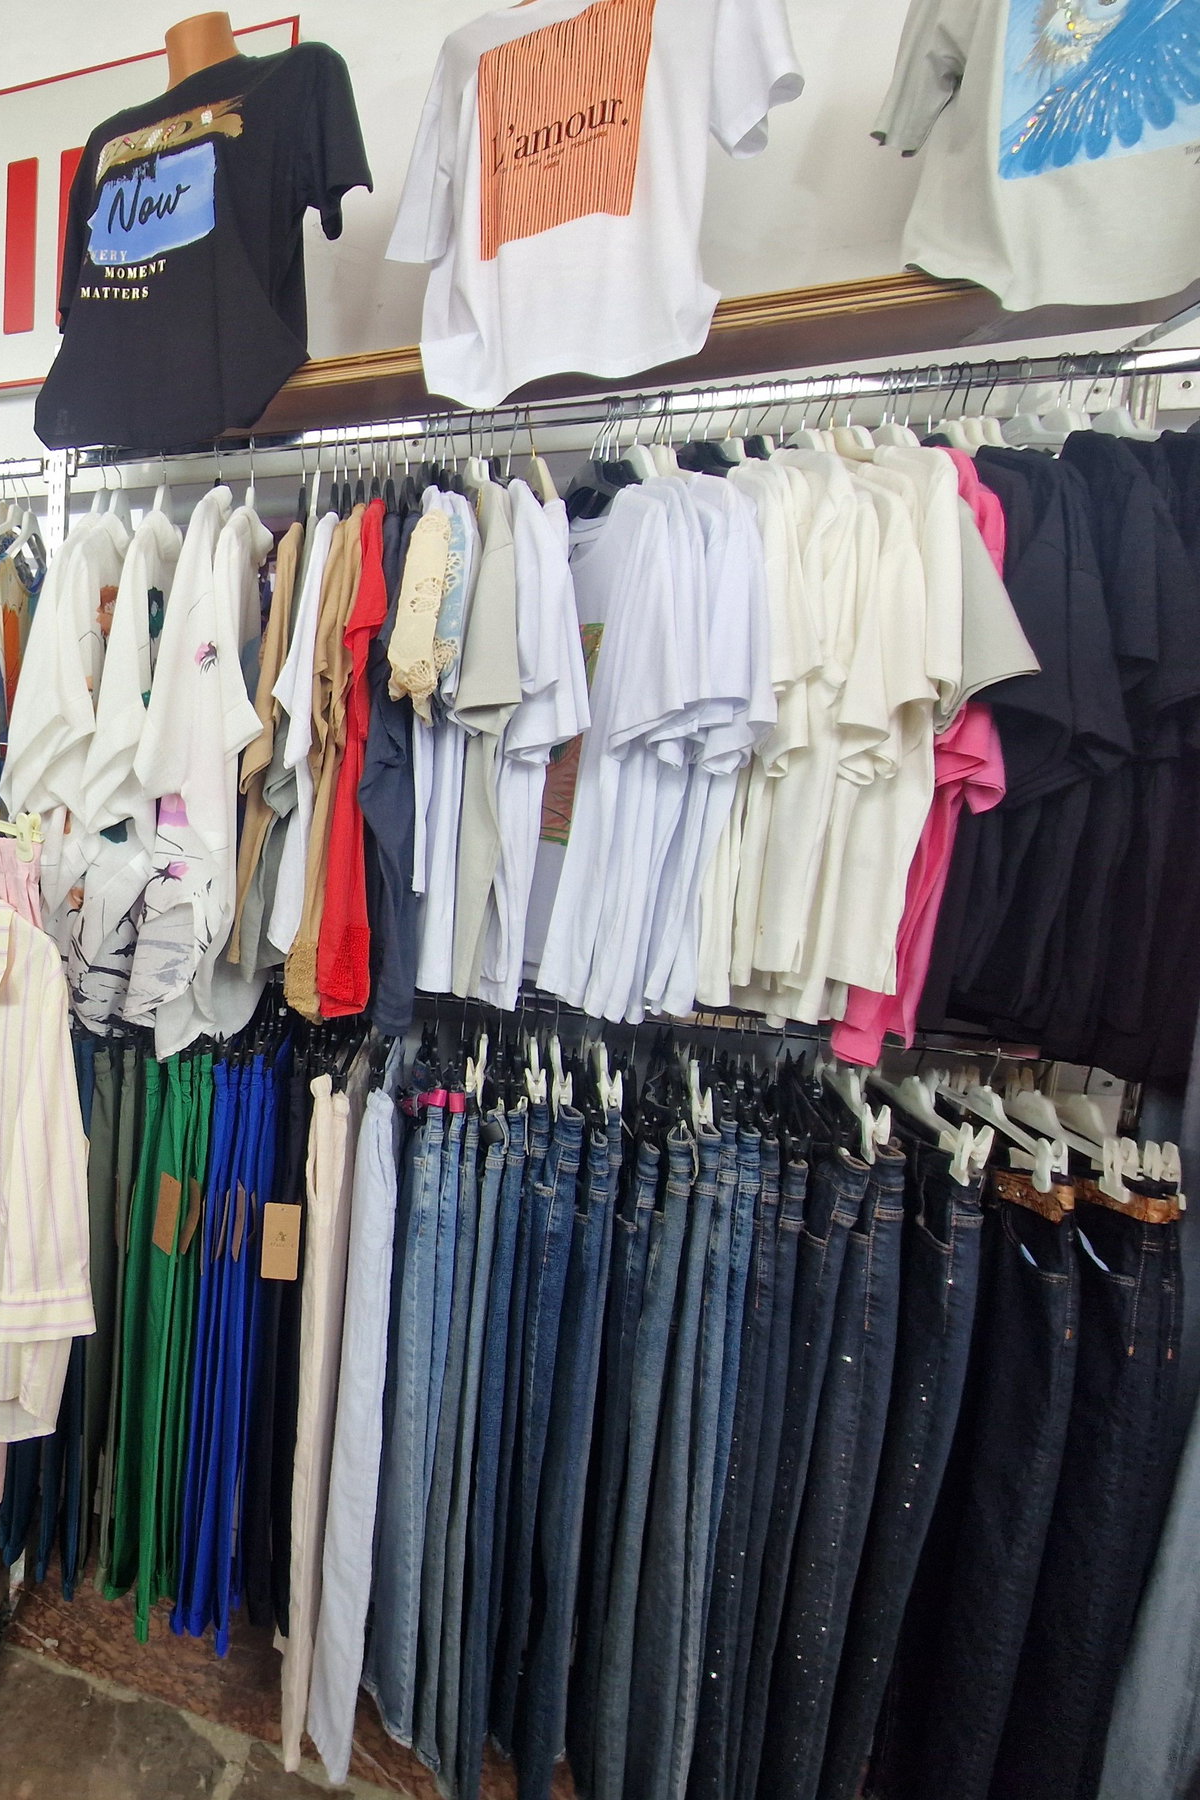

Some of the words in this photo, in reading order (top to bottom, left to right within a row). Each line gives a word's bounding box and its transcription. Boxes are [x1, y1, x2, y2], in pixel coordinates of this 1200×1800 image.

[107, 178, 191, 234] Now
[105, 259, 166, 279] MOMENT
[81, 286, 149, 300] MATTERS
